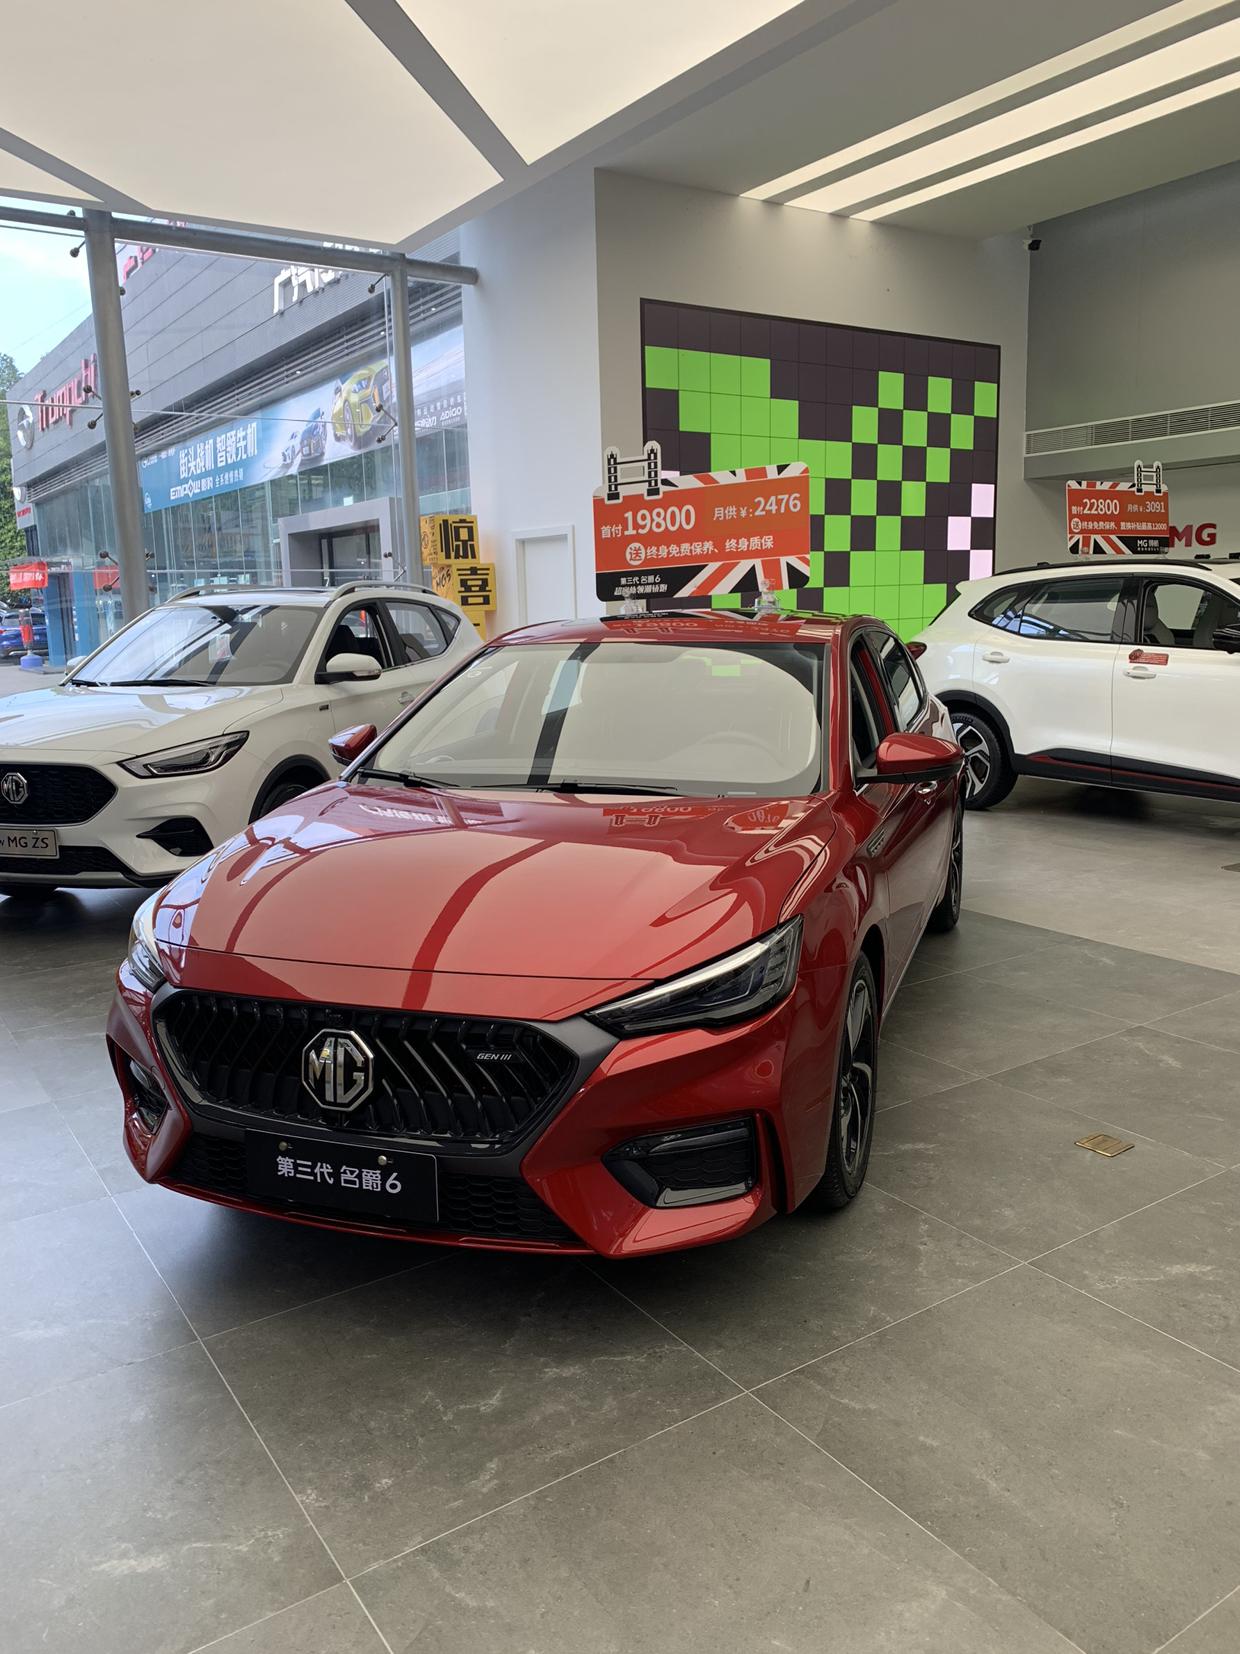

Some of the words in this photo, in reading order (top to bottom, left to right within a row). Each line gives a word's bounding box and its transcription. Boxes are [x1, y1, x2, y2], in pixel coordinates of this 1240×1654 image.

[439, 519, 477, 560] 惊
[1169, 523, 1217, 548] MG
[456, 566, 492, 606] 喜
[7, 836, 28, 848] MG
[32, 837, 49, 849] ZS
[307, 1036, 366, 1103] MG
[476, 1052, 500, 1061] GEN
[276, 1155, 334, 1185] 第三代
[340, 1165, 402, 1194] 名爵6
